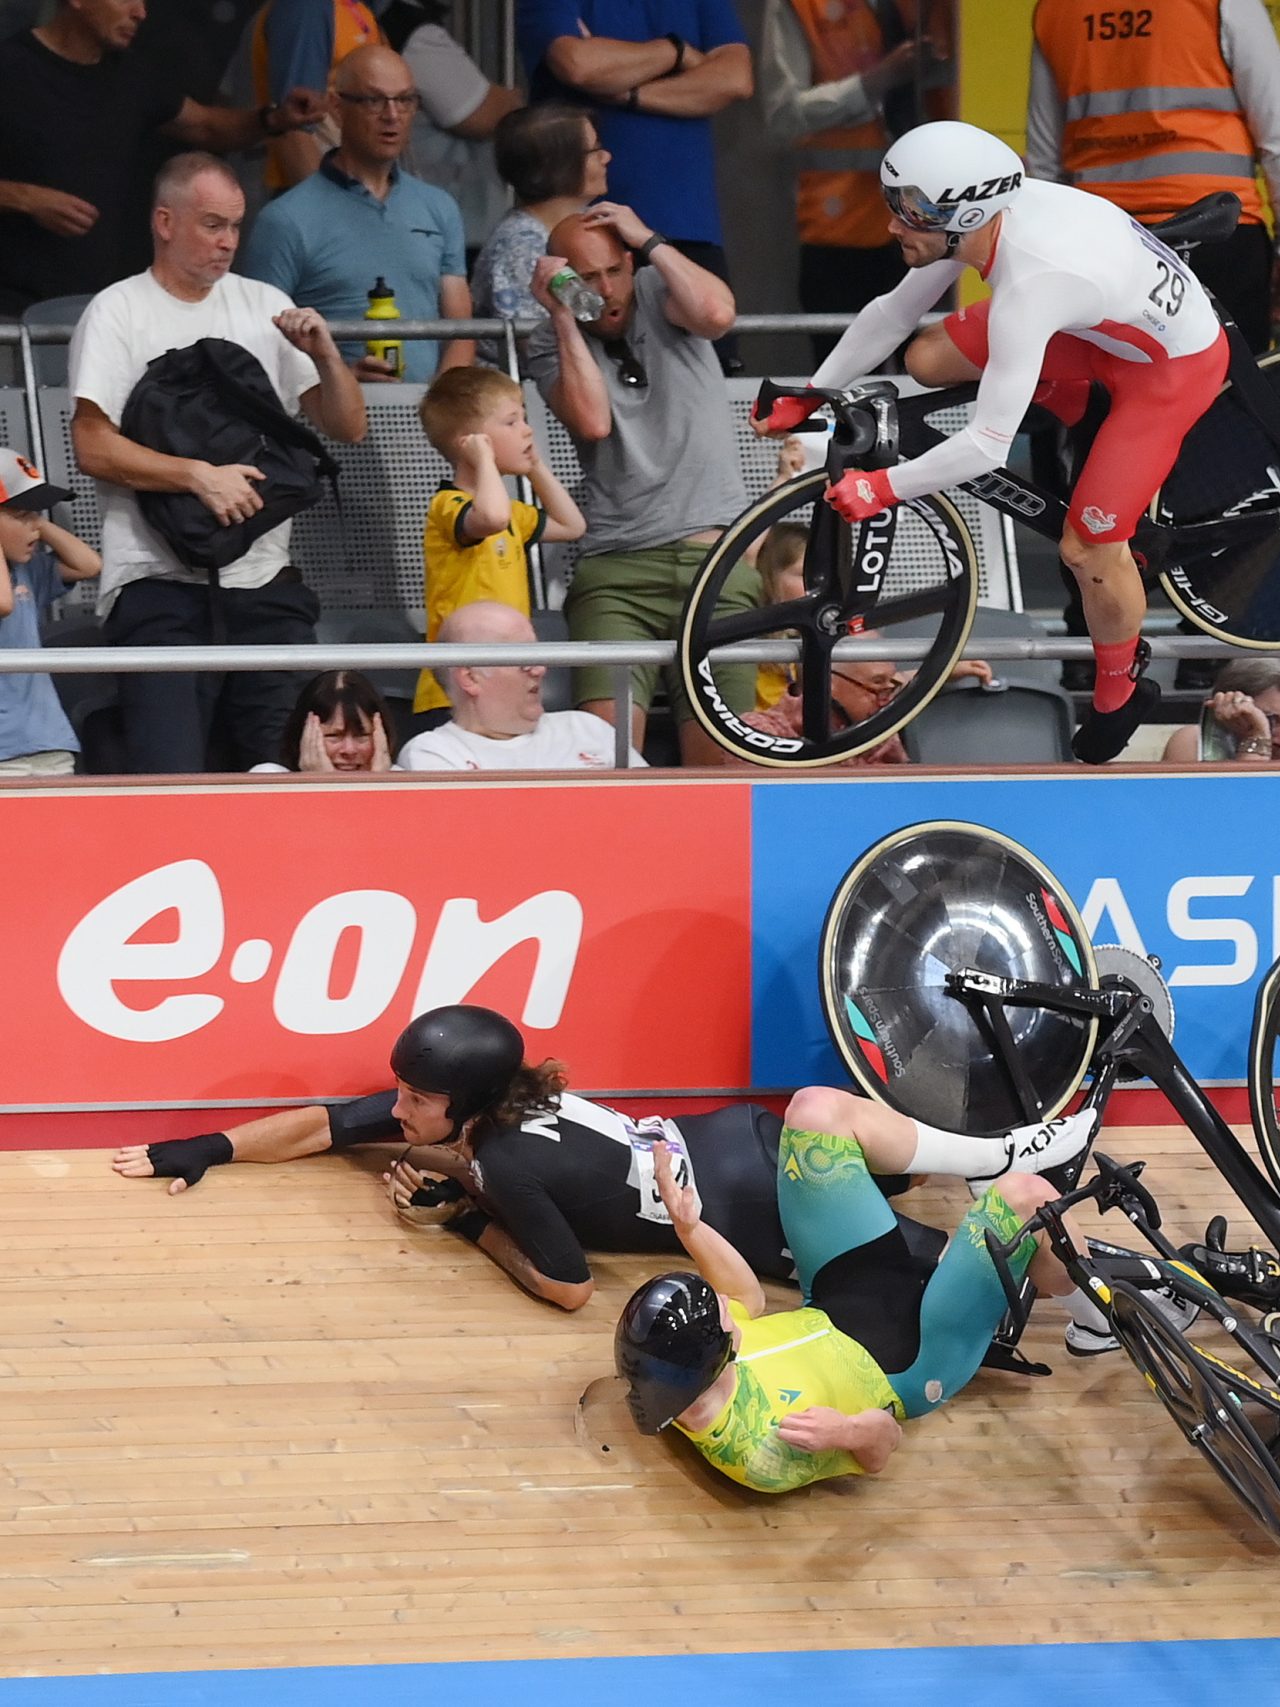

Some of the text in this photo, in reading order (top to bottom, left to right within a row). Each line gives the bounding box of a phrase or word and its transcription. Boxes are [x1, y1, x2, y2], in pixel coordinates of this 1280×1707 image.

[1084, 10, 1152, 41] 1532
[936, 172, 1022, 204] LAZER
[1148, 260, 1185, 317] 29
[856, 506, 893, 593] LOTU
[698, 656, 804, 754] CORIMA
